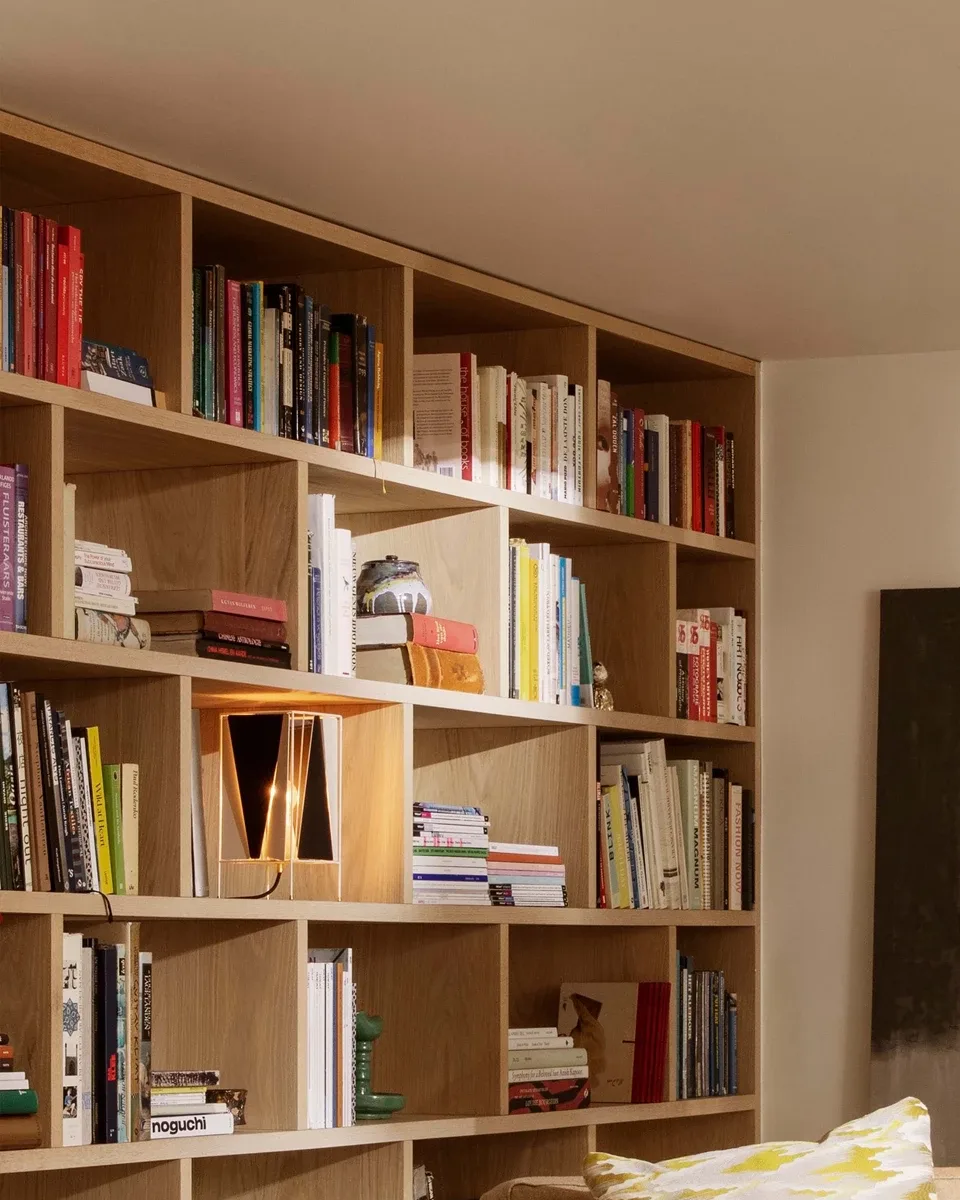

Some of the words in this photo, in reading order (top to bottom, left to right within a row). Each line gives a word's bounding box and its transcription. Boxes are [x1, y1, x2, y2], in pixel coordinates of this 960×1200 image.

[461, 366, 469, 383] the
[461, 386, 470, 417] house
[462, 427, 470, 437] of
[462, 440, 470, 470] books
[17, 500, 25, 563] RESTAURANTS
[17, 565, 24, 573] &
[17, 575, 25, 600] BARS
[65, 759, 73, 797] African
[19, 778, 29, 827] night
[23, 834, 31, 864] out
[152, 1116, 206, 1135] noguchi
